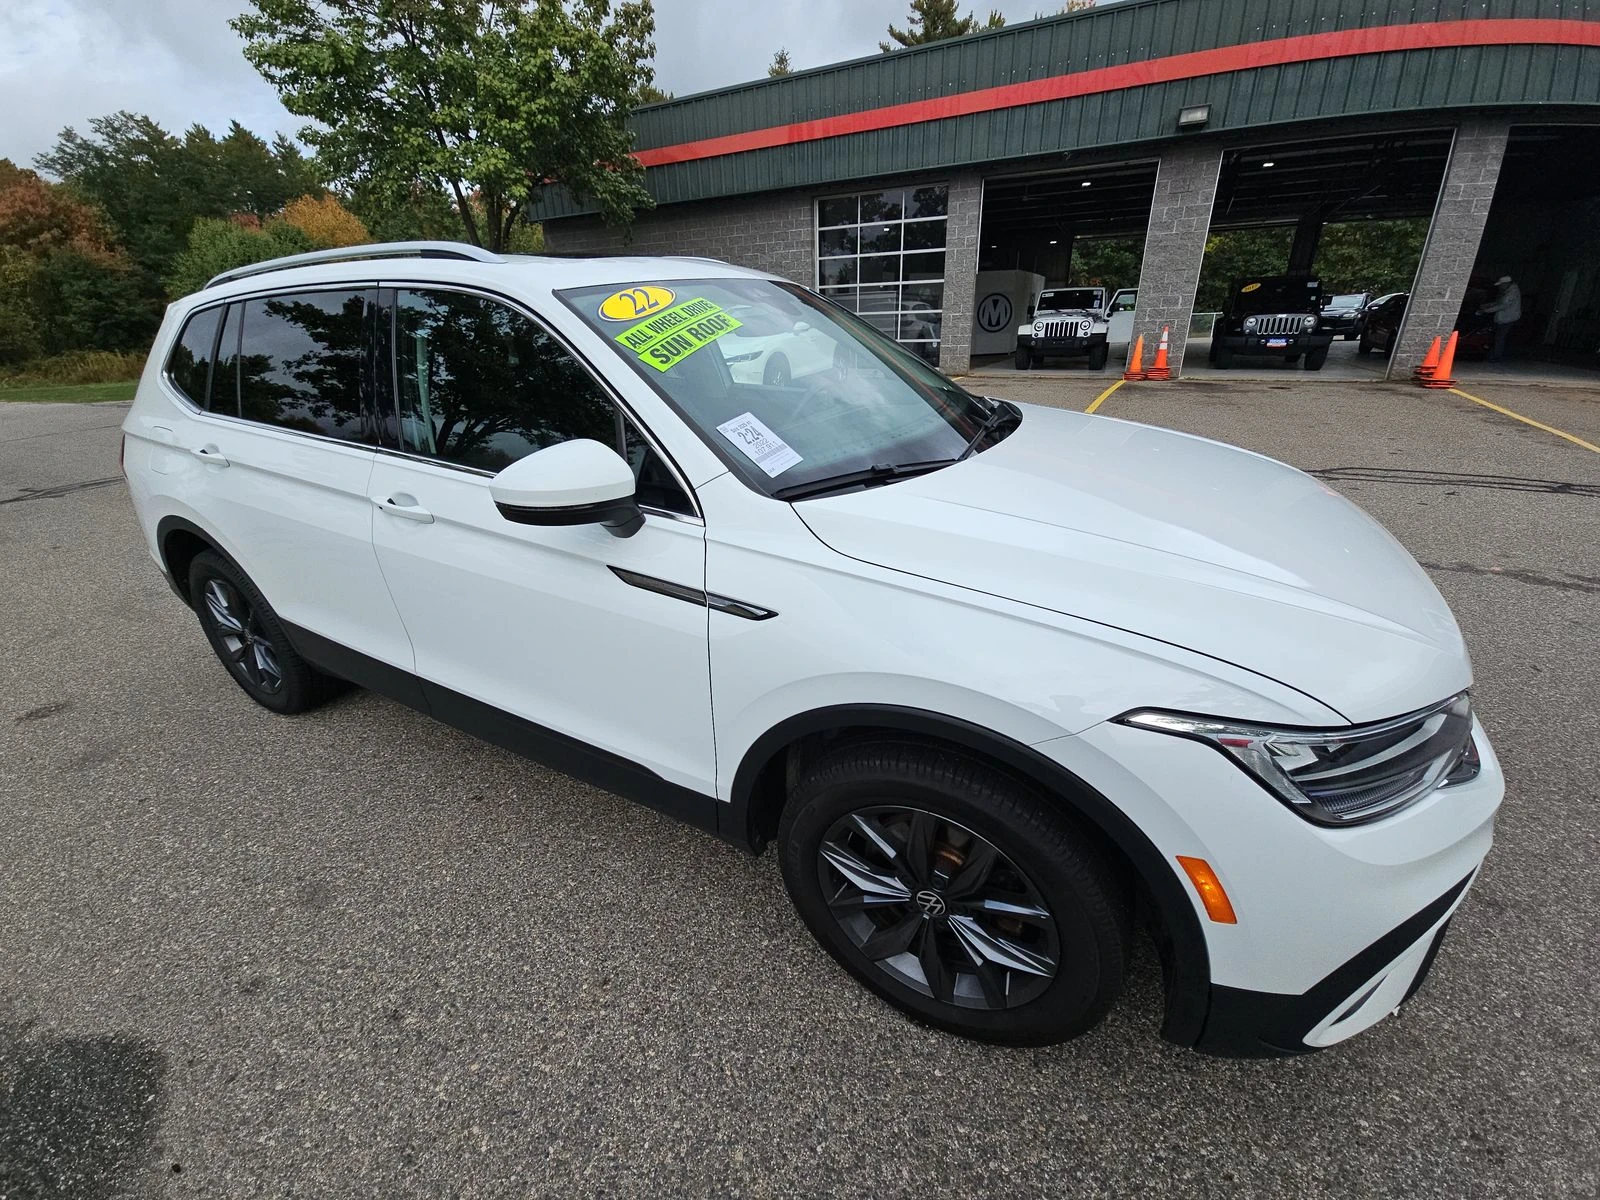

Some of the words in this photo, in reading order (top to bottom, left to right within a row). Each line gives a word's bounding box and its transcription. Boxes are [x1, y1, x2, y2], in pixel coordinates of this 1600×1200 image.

[619, 288, 660, 316] 22
[624, 329, 655, 349] ALL
[645, 311, 689, 335] WHEEL
[681, 299, 715, 318] DRIVE
[649, 334, 695, 365] SUN
[688, 314, 732, 342] ROOF
[737, 425, 764, 445] 2:24
